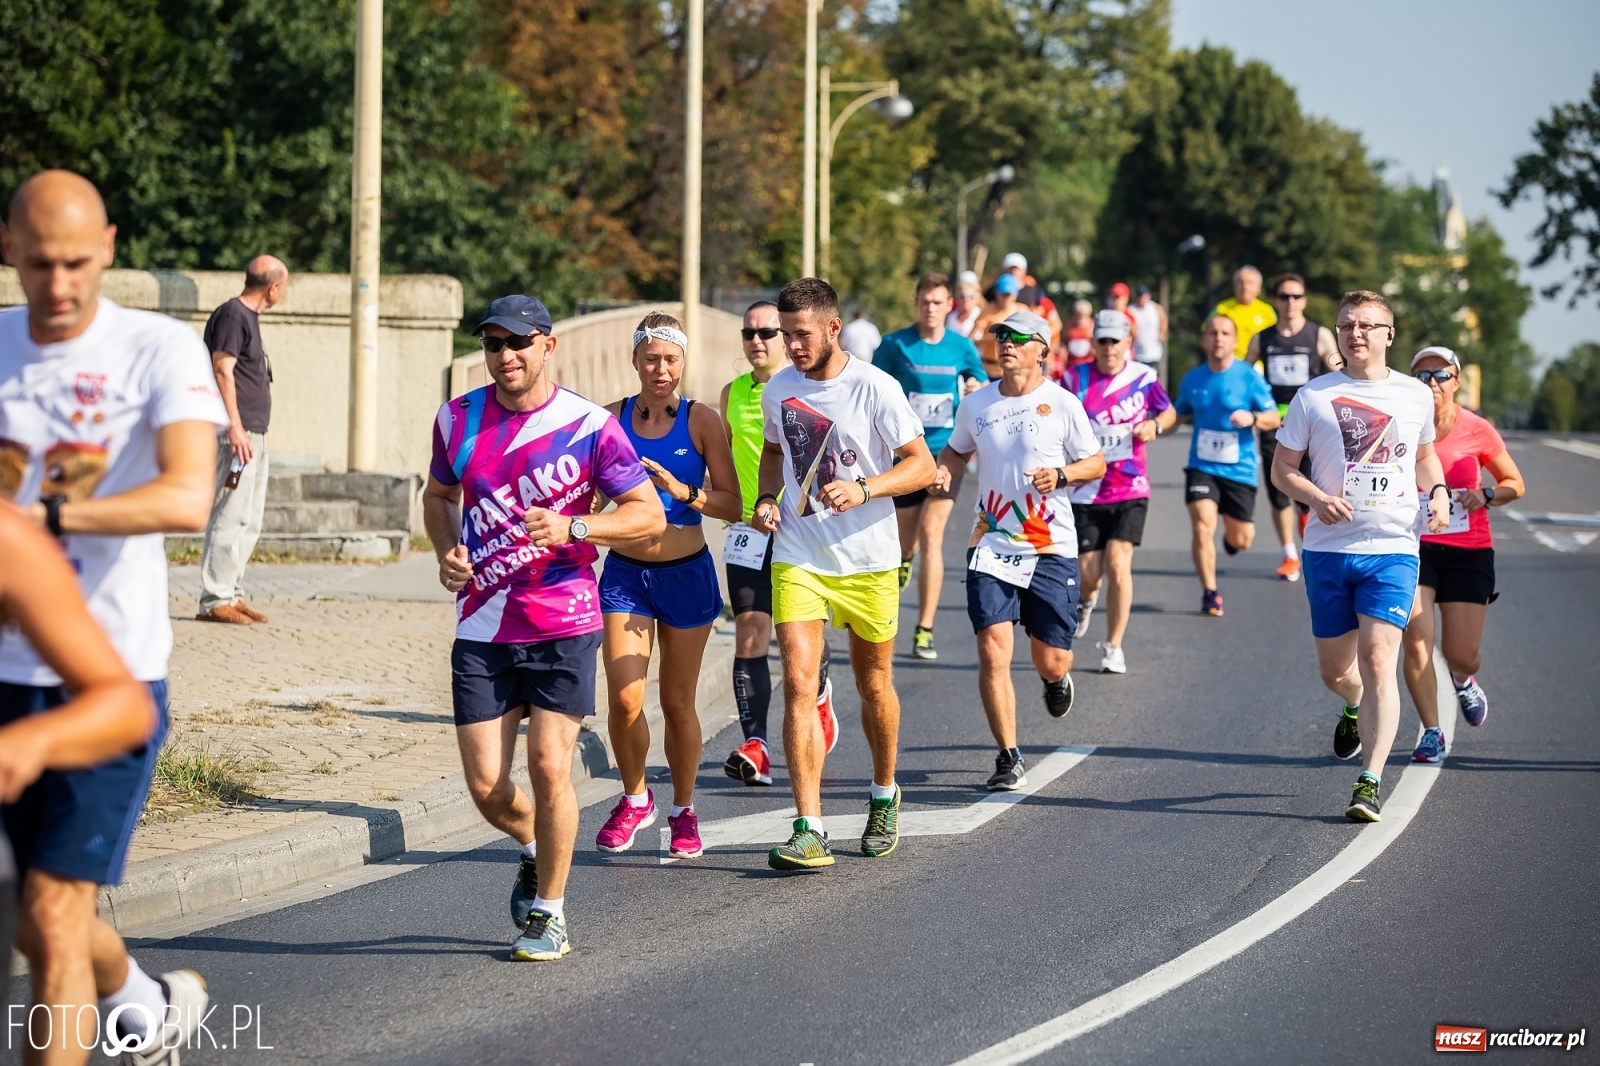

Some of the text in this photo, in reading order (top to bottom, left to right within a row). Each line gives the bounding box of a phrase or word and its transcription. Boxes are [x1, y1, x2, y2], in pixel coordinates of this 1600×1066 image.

[674, 448, 688, 456] 4F
[1371, 477, 1388, 491] 19
[469, 454, 581, 538] RAFAKO
[734, 534, 749, 547] 88
